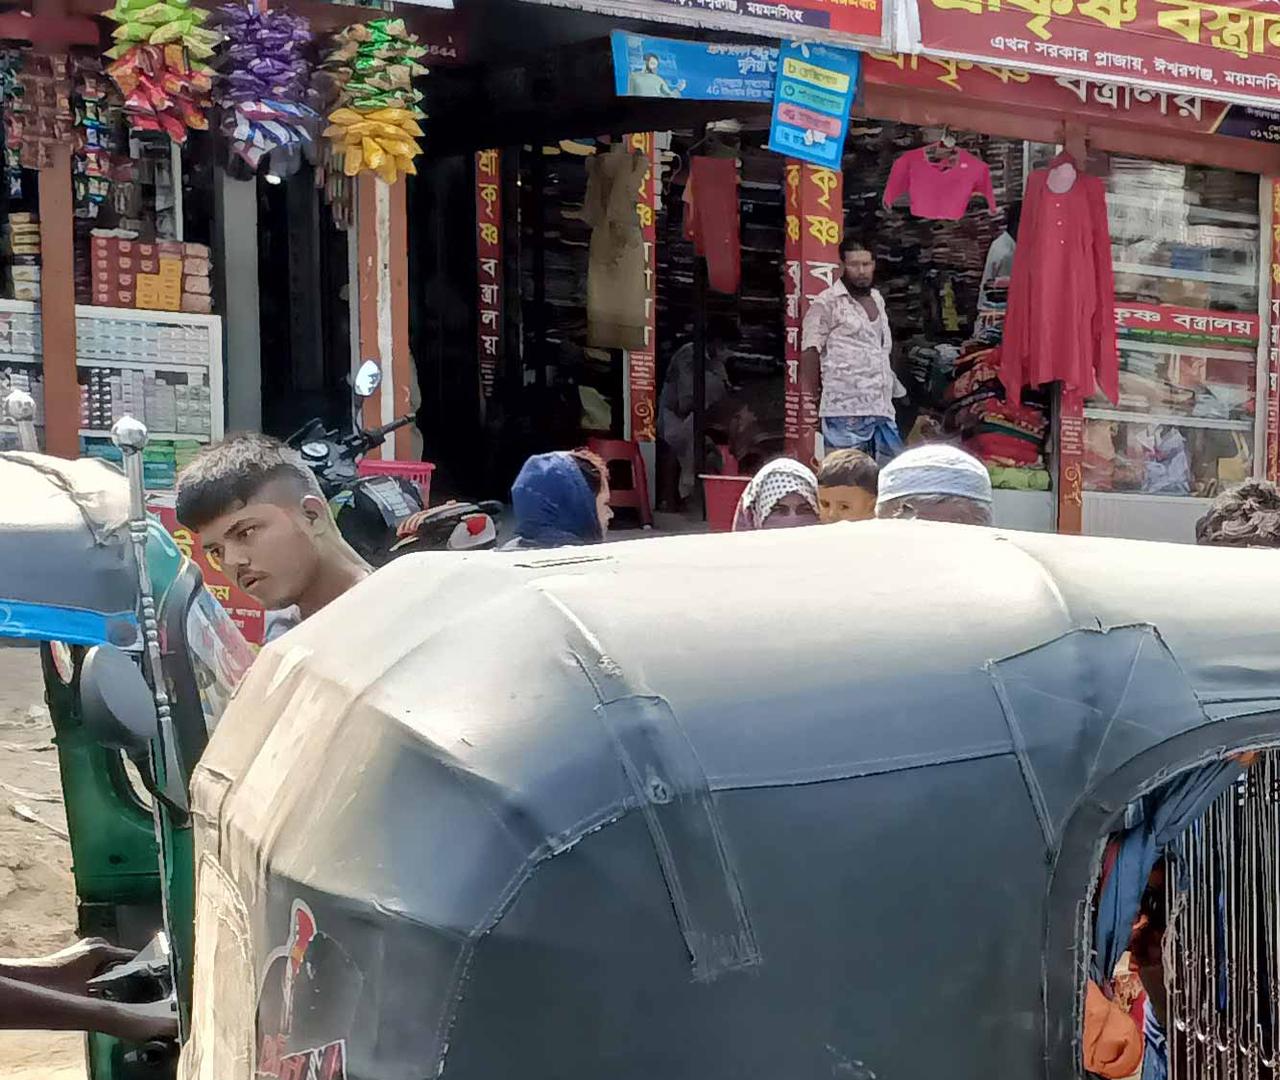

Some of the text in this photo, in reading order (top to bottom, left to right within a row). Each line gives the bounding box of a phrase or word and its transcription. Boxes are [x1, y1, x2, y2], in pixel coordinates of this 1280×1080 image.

[990, 35, 1030, 54] এখন
[1034, 41, 1089, 63] সরকার
[1172, 312, 1254, 336] বস্ত্রালয়
